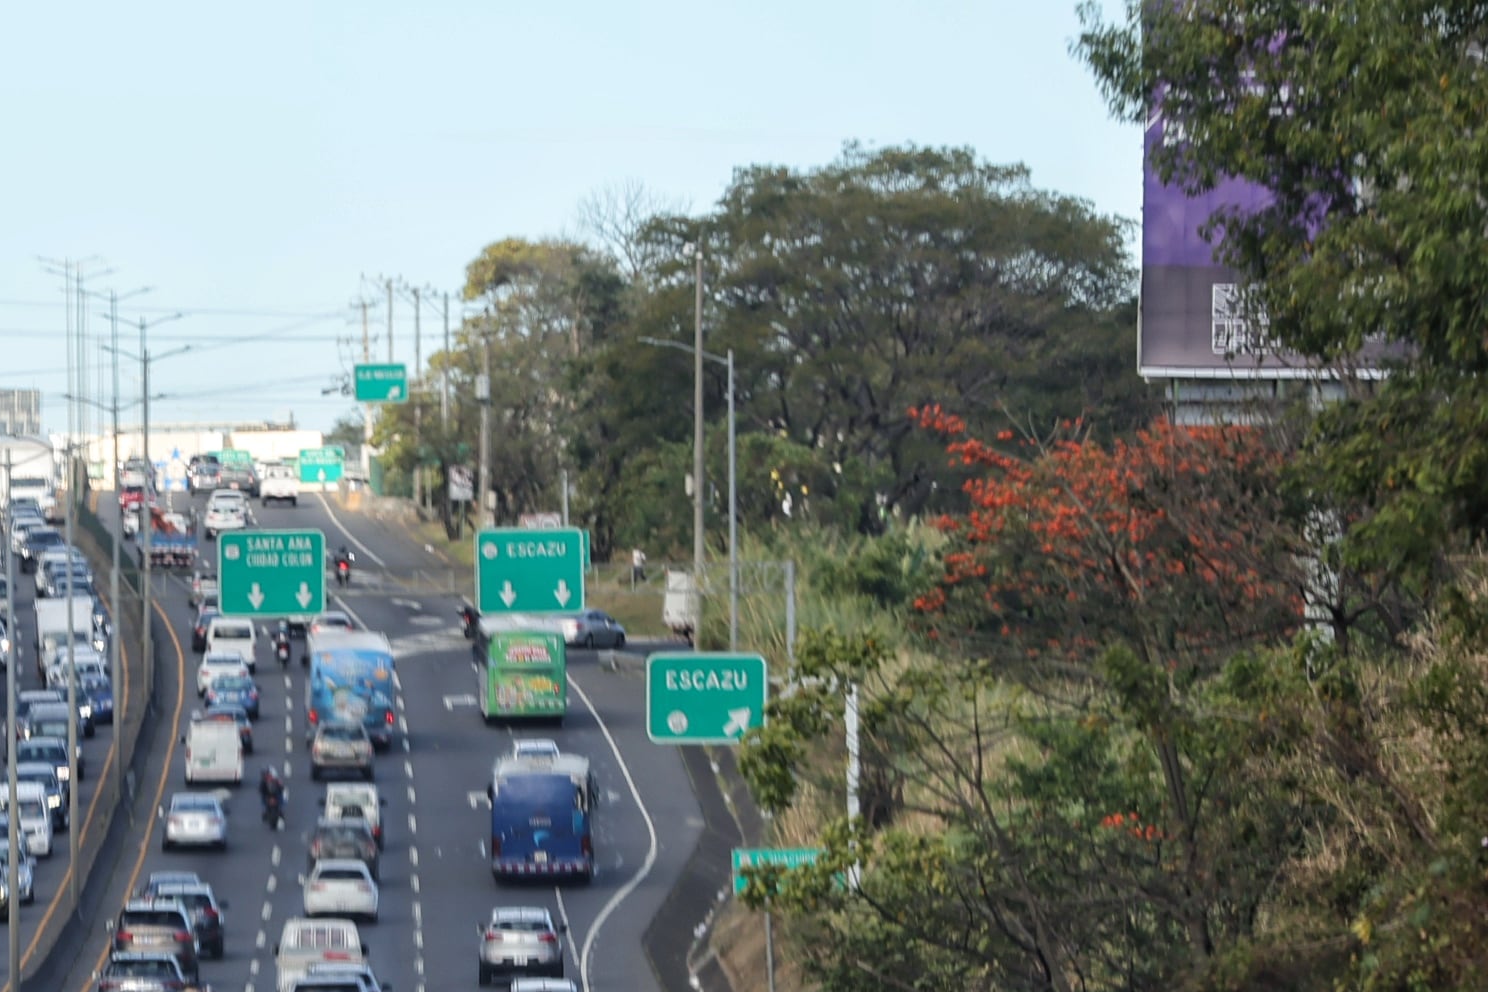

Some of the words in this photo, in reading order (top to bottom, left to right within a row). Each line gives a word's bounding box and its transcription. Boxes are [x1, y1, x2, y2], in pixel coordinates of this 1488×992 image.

[246, 536, 284, 551] SANTA
[288, 536, 313, 551] ANA
[506, 541, 566, 559] ESCAZU
[246, 552, 279, 567] CIUDAD
[282, 552, 313, 567] COLON
[665, 668, 748, 691] ESCAZU
